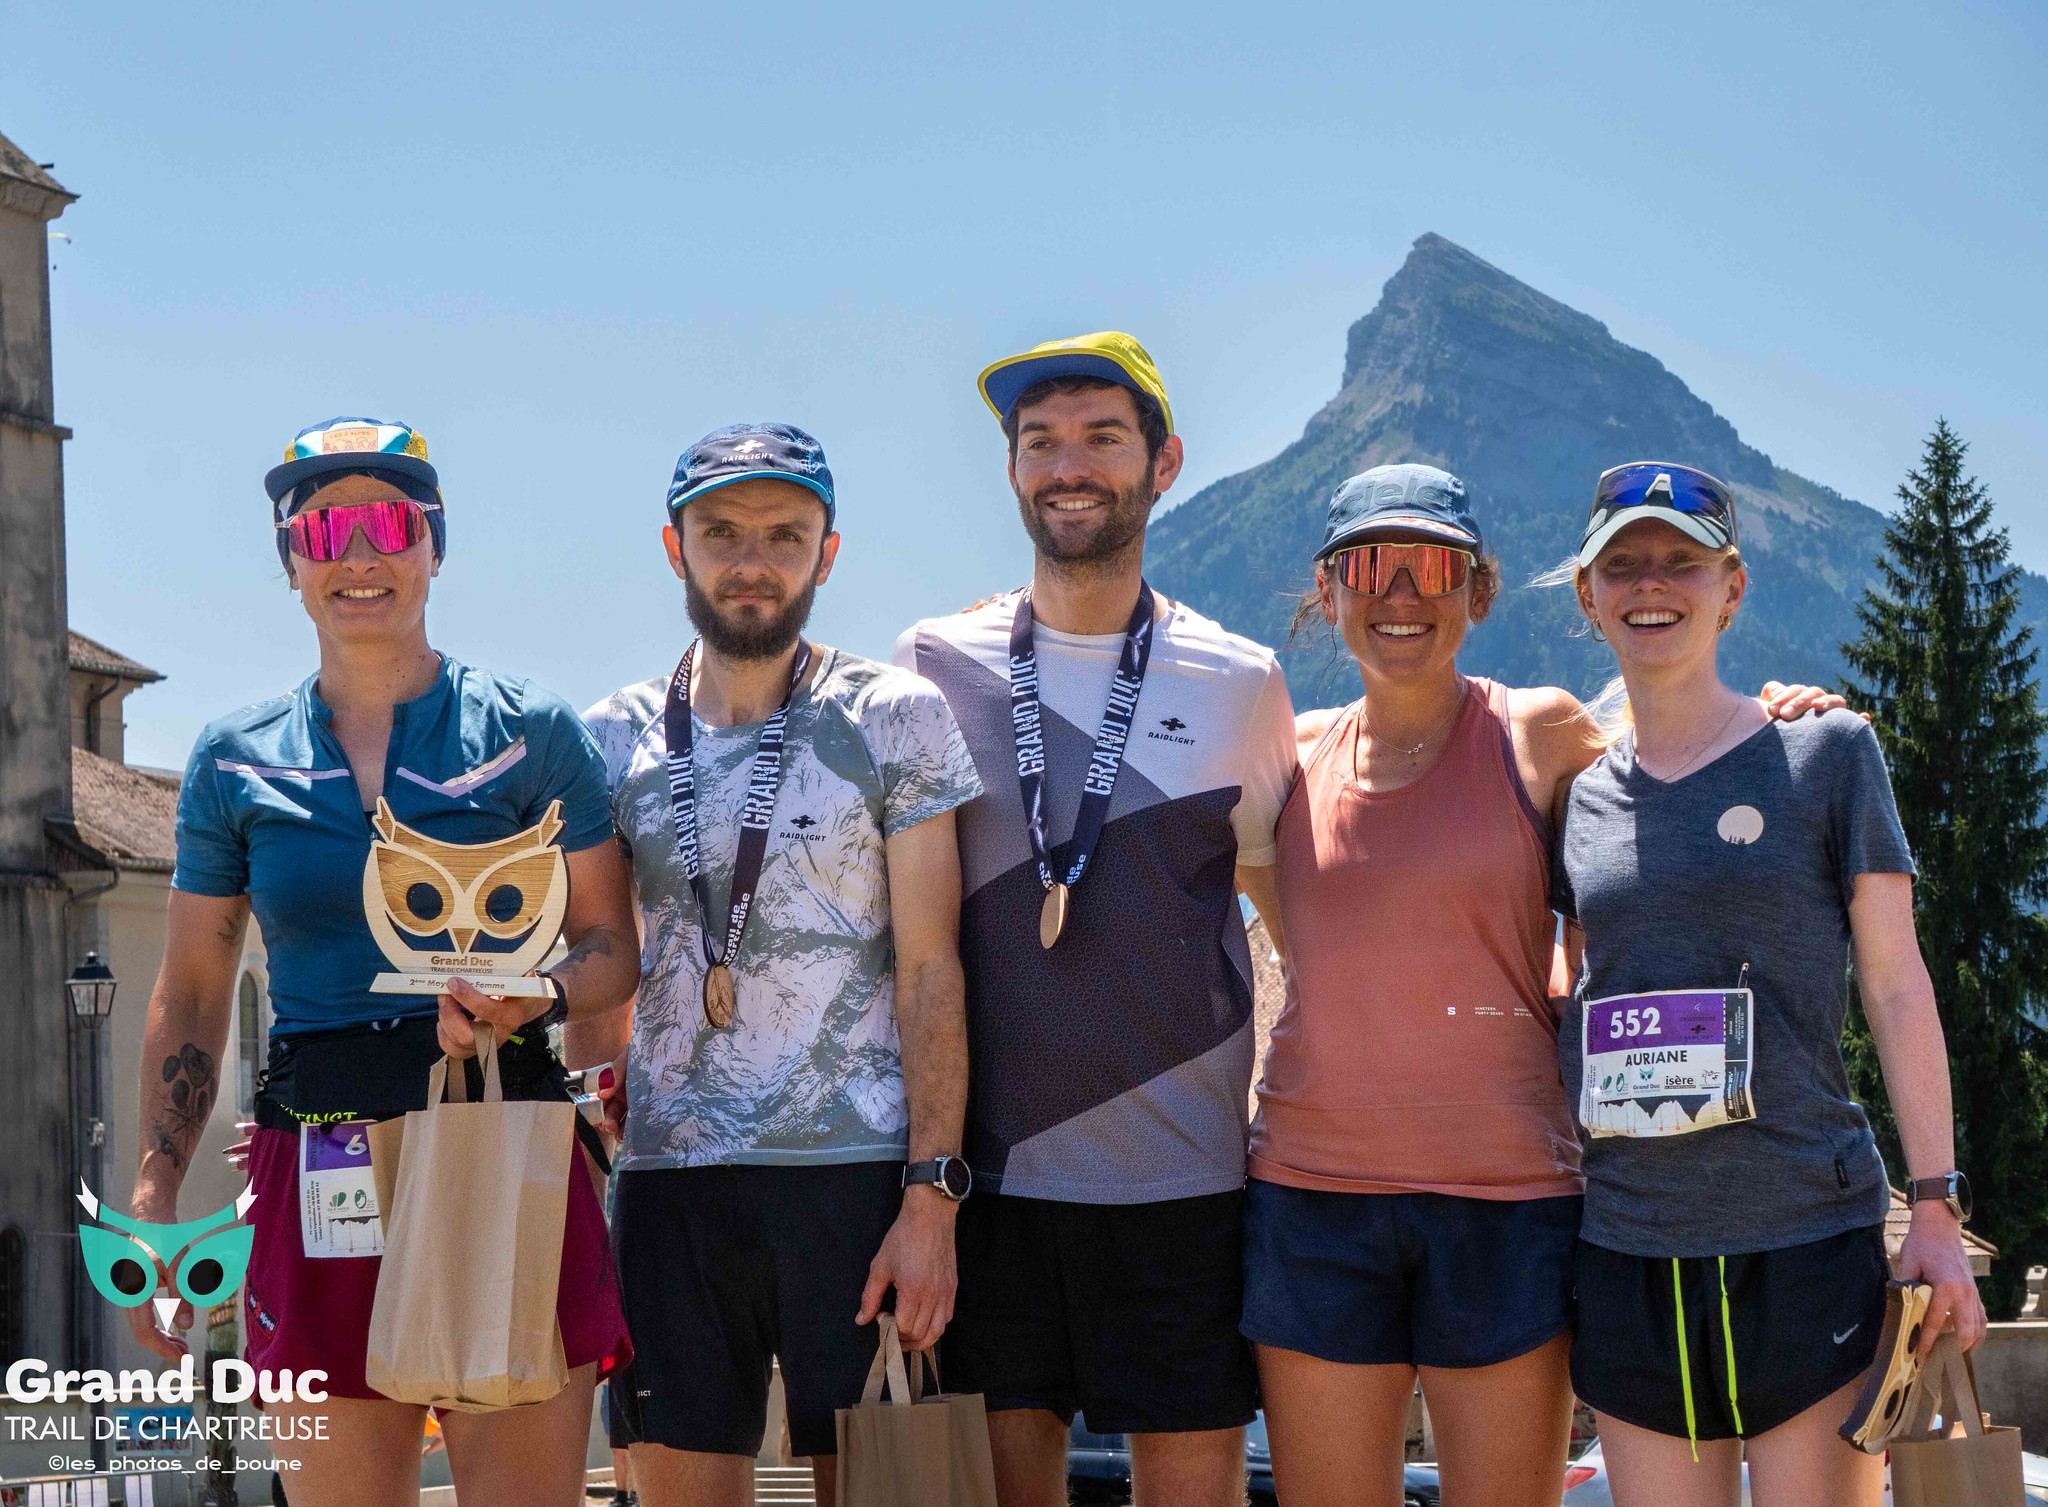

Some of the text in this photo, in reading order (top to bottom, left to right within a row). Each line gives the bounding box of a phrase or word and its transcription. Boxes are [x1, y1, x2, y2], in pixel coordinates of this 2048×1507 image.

[721, 453, 774, 464] RAIDLIGHT
[1333, 478, 1447, 522] ciele
[1010, 651, 1045, 778] GRAND DUC
[1084, 669, 1142, 796] GRAND DUC
[1147, 732, 1195, 746] RAIDLIGHT
[742, 751, 782, 830] GRAND
[667, 748, 700, 881] GRAND DUC
[779, 832, 827, 842] RAIDLIGHT
[731, 904, 741, 924] de
[724, 892, 751, 966] hartreuse
[431, 956, 493, 967] Grand Duc
[427, 979, 448, 988] Moy
[475, 981, 505, 989] Femme
[1609, 1006, 1661, 1039] 552
[1625, 1050, 1688, 1067] AURIANE
[1665, 1075, 1694, 1085] isère
[345, 1134, 368, 1156] 6
